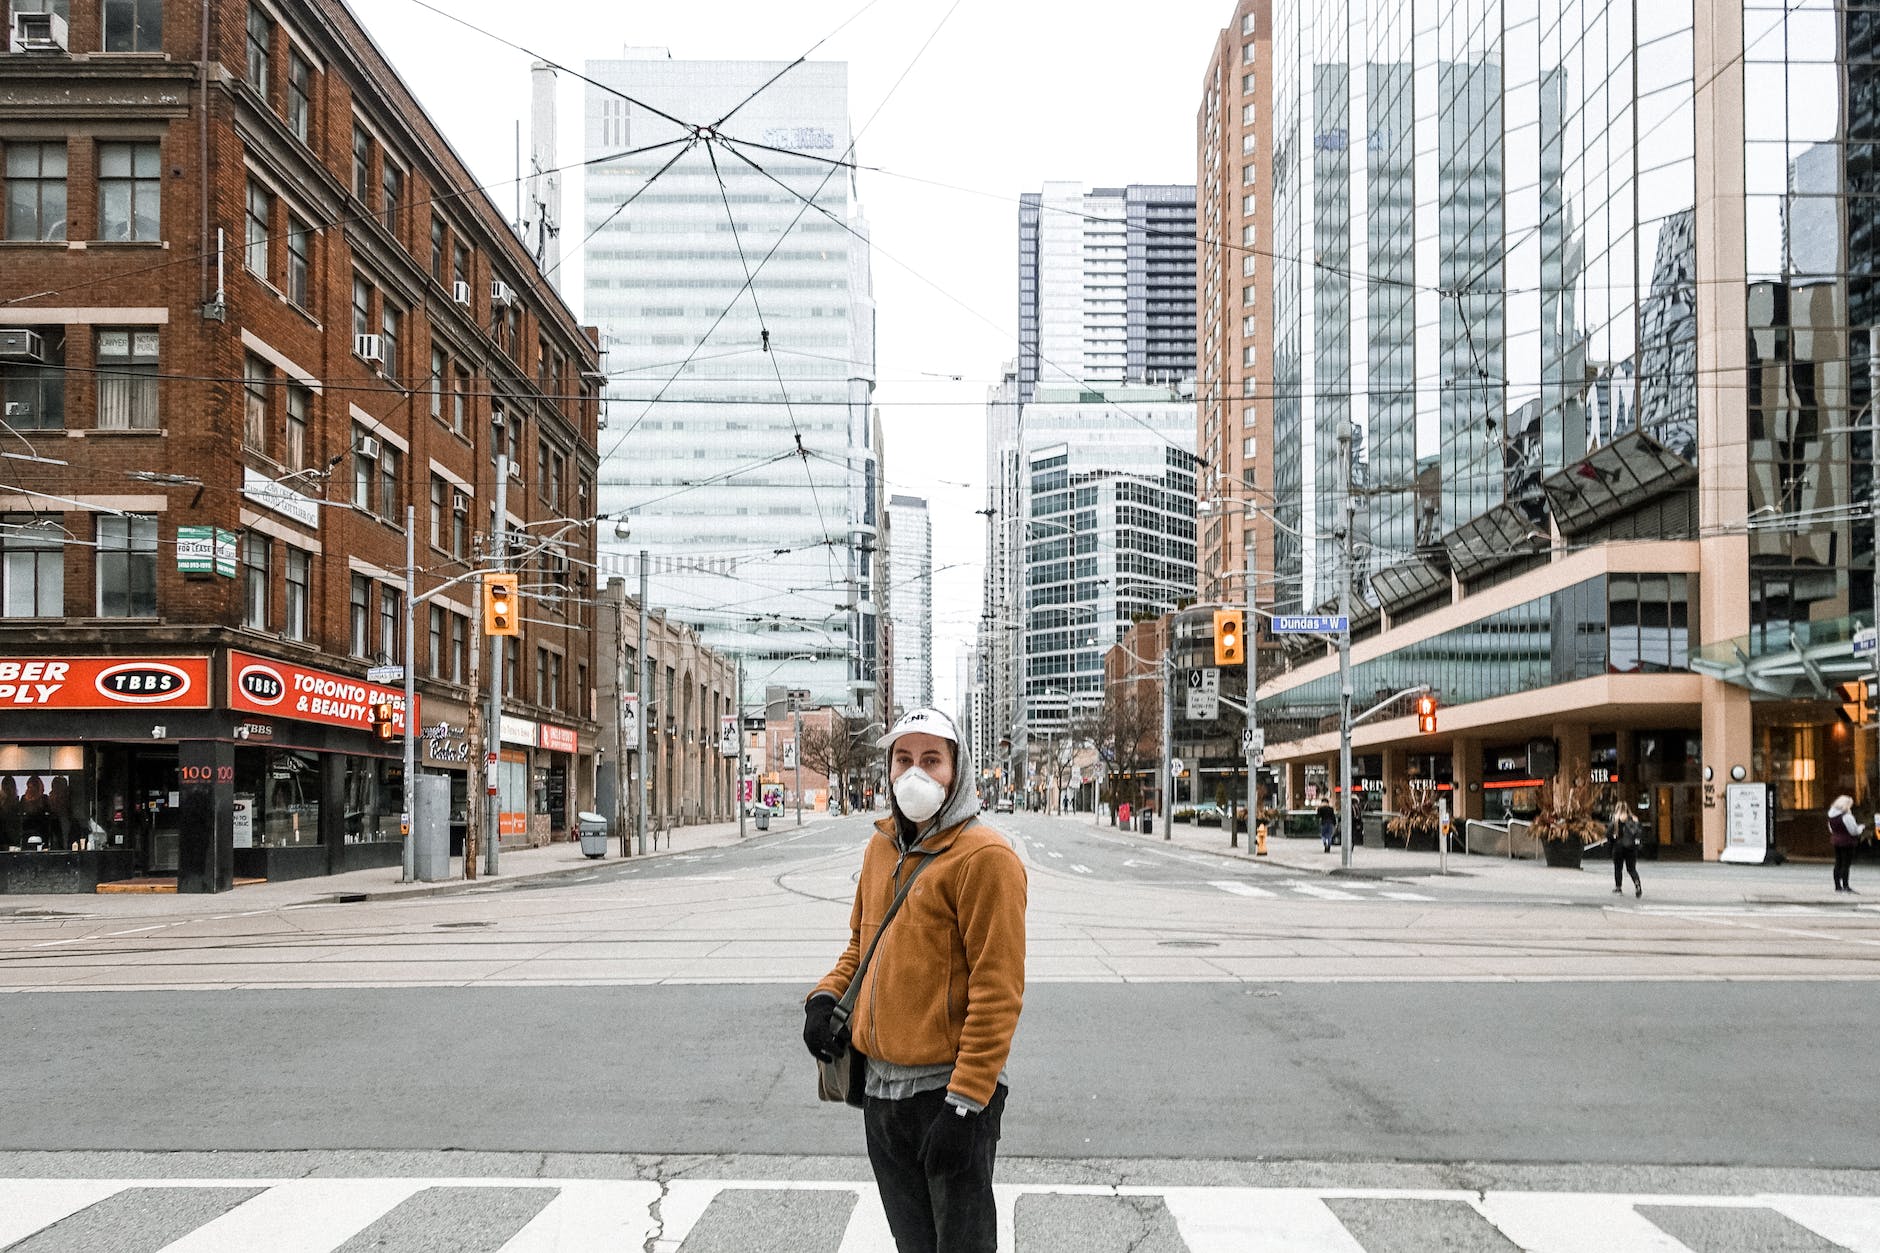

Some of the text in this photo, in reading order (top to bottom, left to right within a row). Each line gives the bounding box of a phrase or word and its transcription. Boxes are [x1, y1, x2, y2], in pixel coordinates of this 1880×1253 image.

[192, 544, 211, 552] LEASE
[1280, 617, 1319, 629] Dundas
[1329, 617, 1340, 629] W
[115, 675, 172, 690] TBBS
[248, 676, 277, 695] TBBS
[294, 673, 414, 711] TORONTO BARBE
[296, 695, 405, 728] & BEAUTY SPL
[244, 723, 272, 735] TBBS
[182, 766, 233, 780] 100 100
